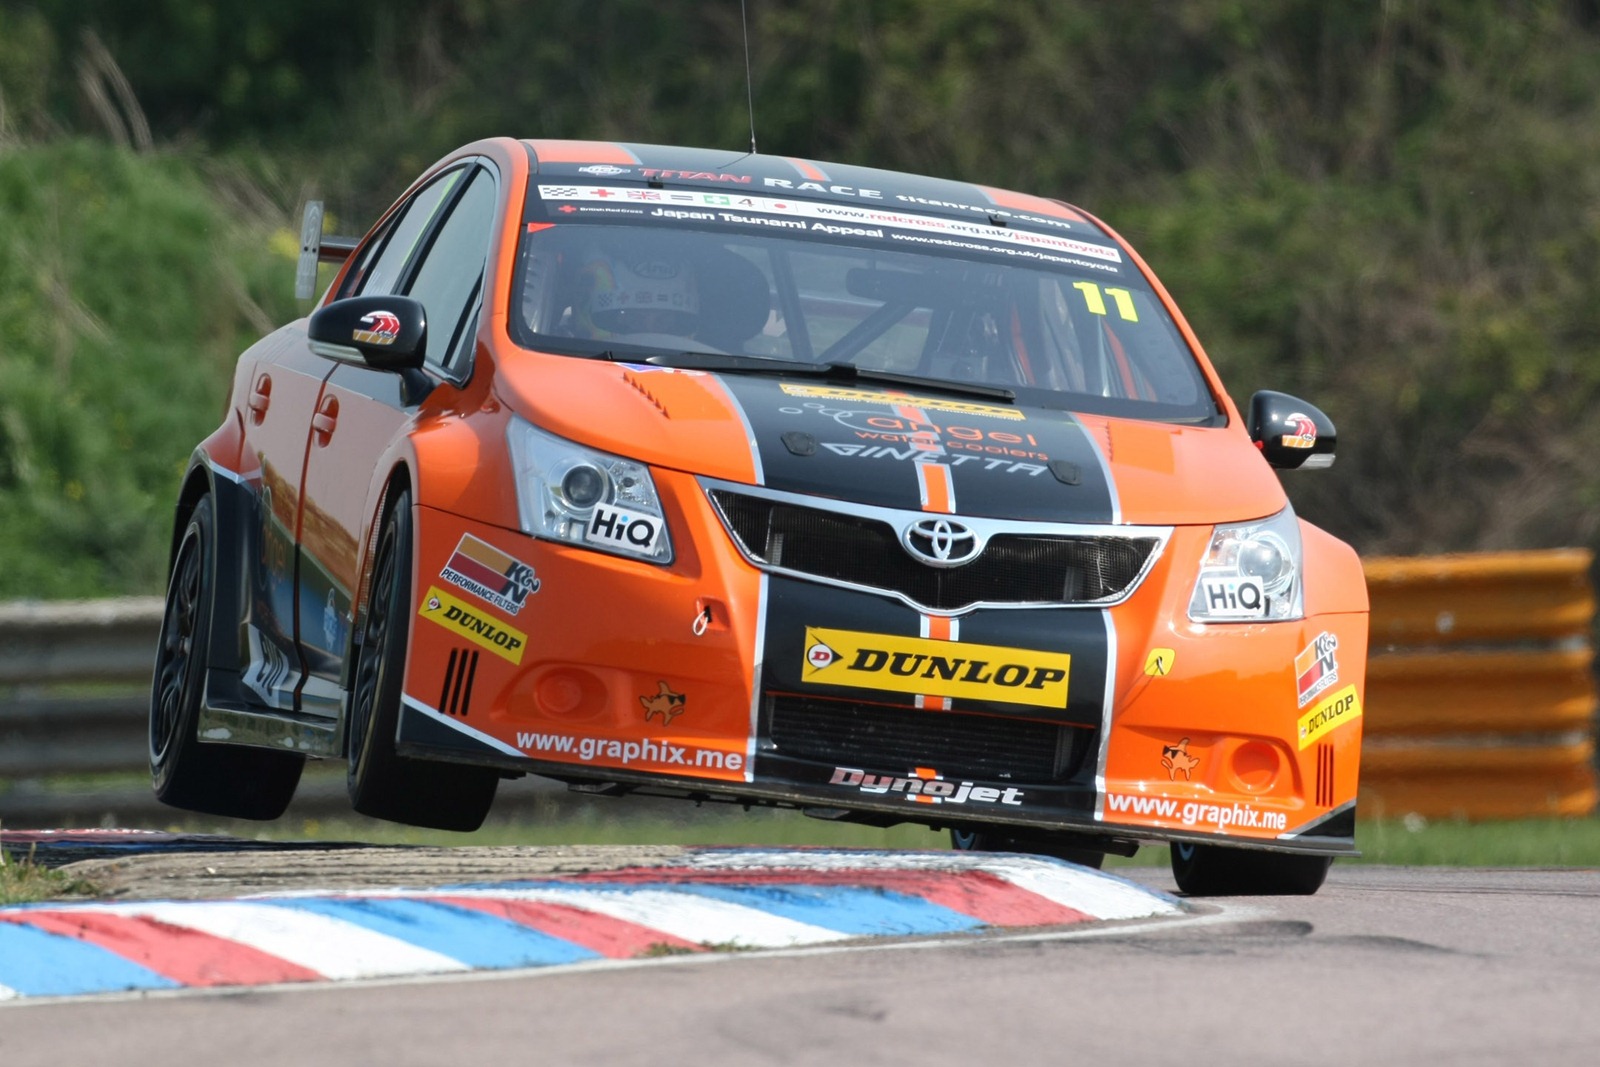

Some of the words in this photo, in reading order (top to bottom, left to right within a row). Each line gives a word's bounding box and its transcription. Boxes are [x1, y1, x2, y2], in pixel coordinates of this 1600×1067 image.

[638, 168, 752, 183] TITAN
[764, 178, 883, 199] RACE
[896, 195, 1071, 229] titanrace.com
[651, 208, 715, 220] Japan
[719, 213, 807, 229] Tsunami
[812, 223, 883, 238] Appeal
[817, 207, 1117, 258] www.redcross.org.uk/japantoyota
[891, 233, 1118, 273] www.redcross.org.uk/japantoyota
[1072, 281, 1139, 322] 11
[855, 431, 935, 446] water
[947, 439, 1049, 461] coolers
[866, 415, 1038, 446] angel
[820, 443, 1049, 476] GINETTA
[591, 509, 654, 548] HiQ
[441, 568, 496, 603] PERFORMANCE
[493, 594, 519, 614] FILTERS
[1207, 582, 1261, 610] HiQ
[443, 606, 521, 651] DUNLOP
[847, 649, 1066, 690] DUNLOP
[1308, 694, 1354, 734] DUNLOP
[516, 732, 743, 770] www.graphix.me
[829, 767, 1024, 805] Dynojet
[1107, 793, 1287, 829] www.graphix.me
